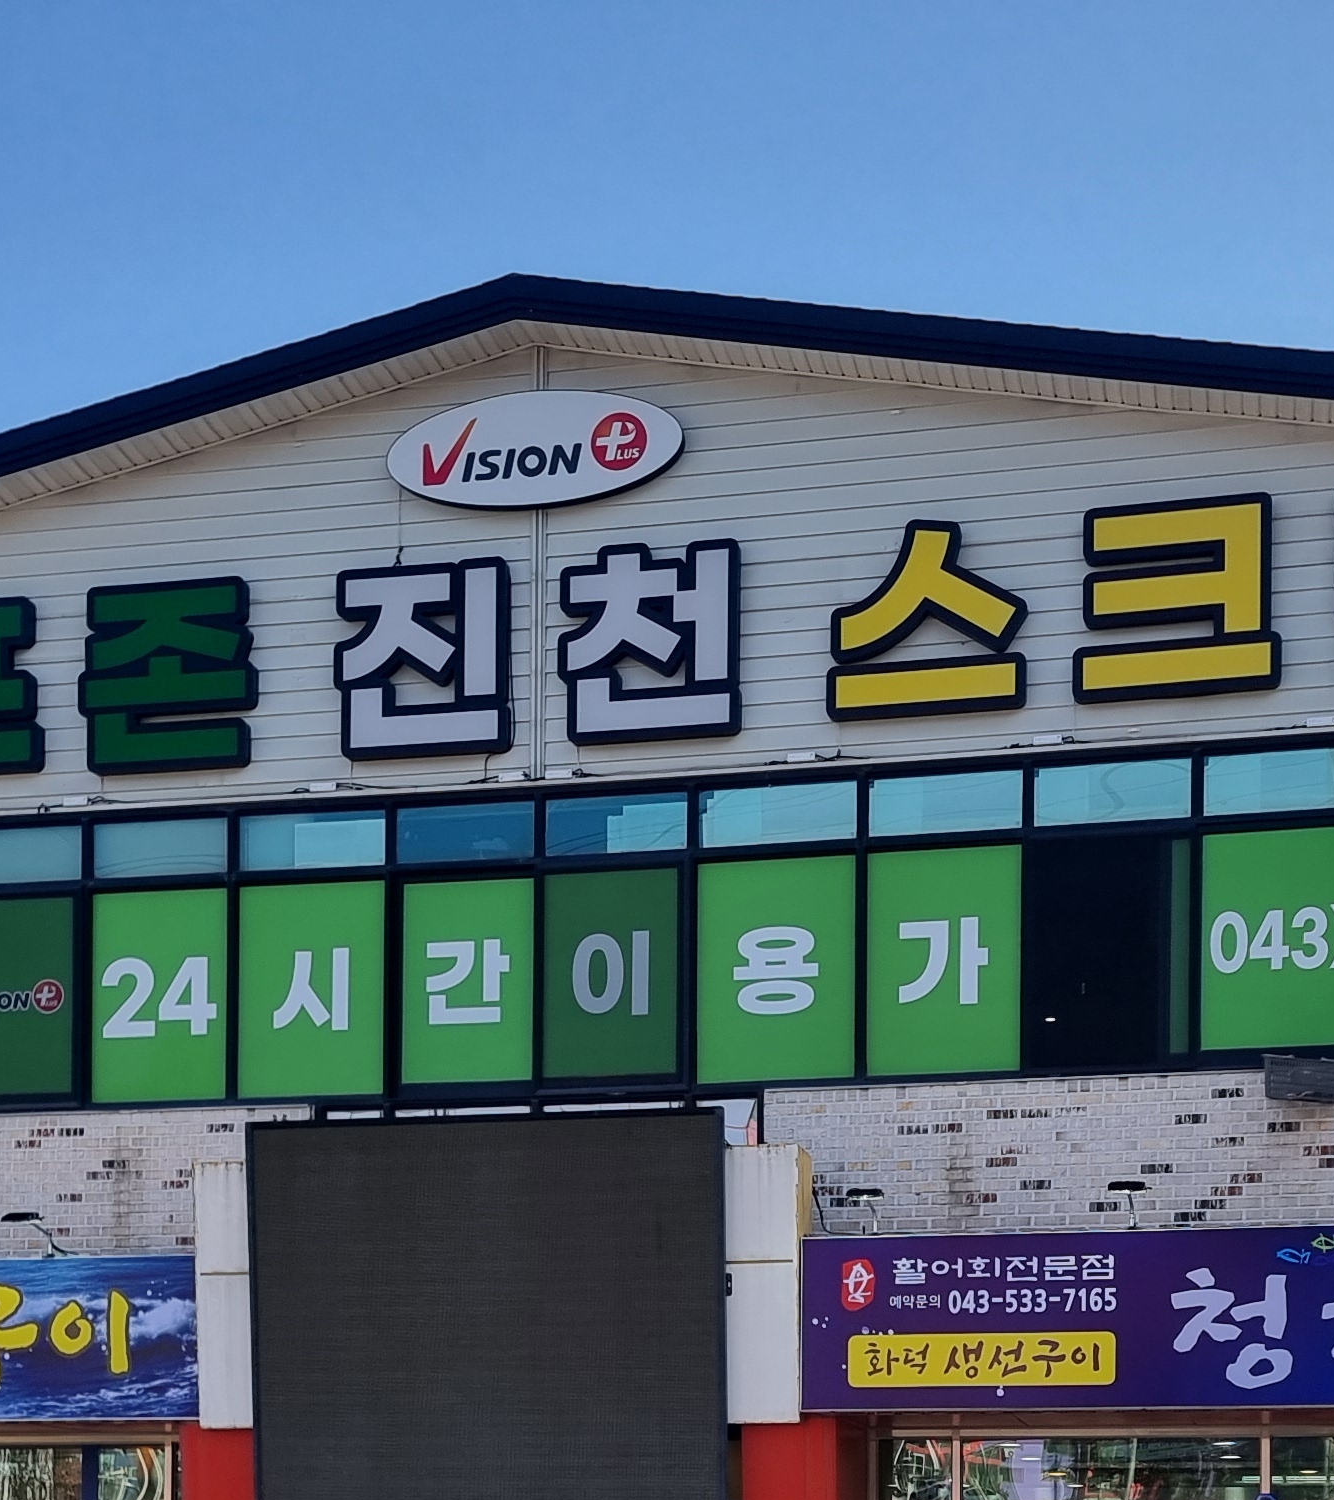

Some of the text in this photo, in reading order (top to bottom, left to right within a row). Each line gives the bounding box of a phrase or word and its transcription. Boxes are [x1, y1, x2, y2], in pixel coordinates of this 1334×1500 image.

[422, 417, 582, 486] VISION
[335, 538, 742, 760] 진천
[892, 1254, 1115, 1285] 활어회전문점
[889, 1287, 1117, 1314] 예약문의 043-533-7165
[864, 1340, 1101, 1379] 화덕 생선구이
